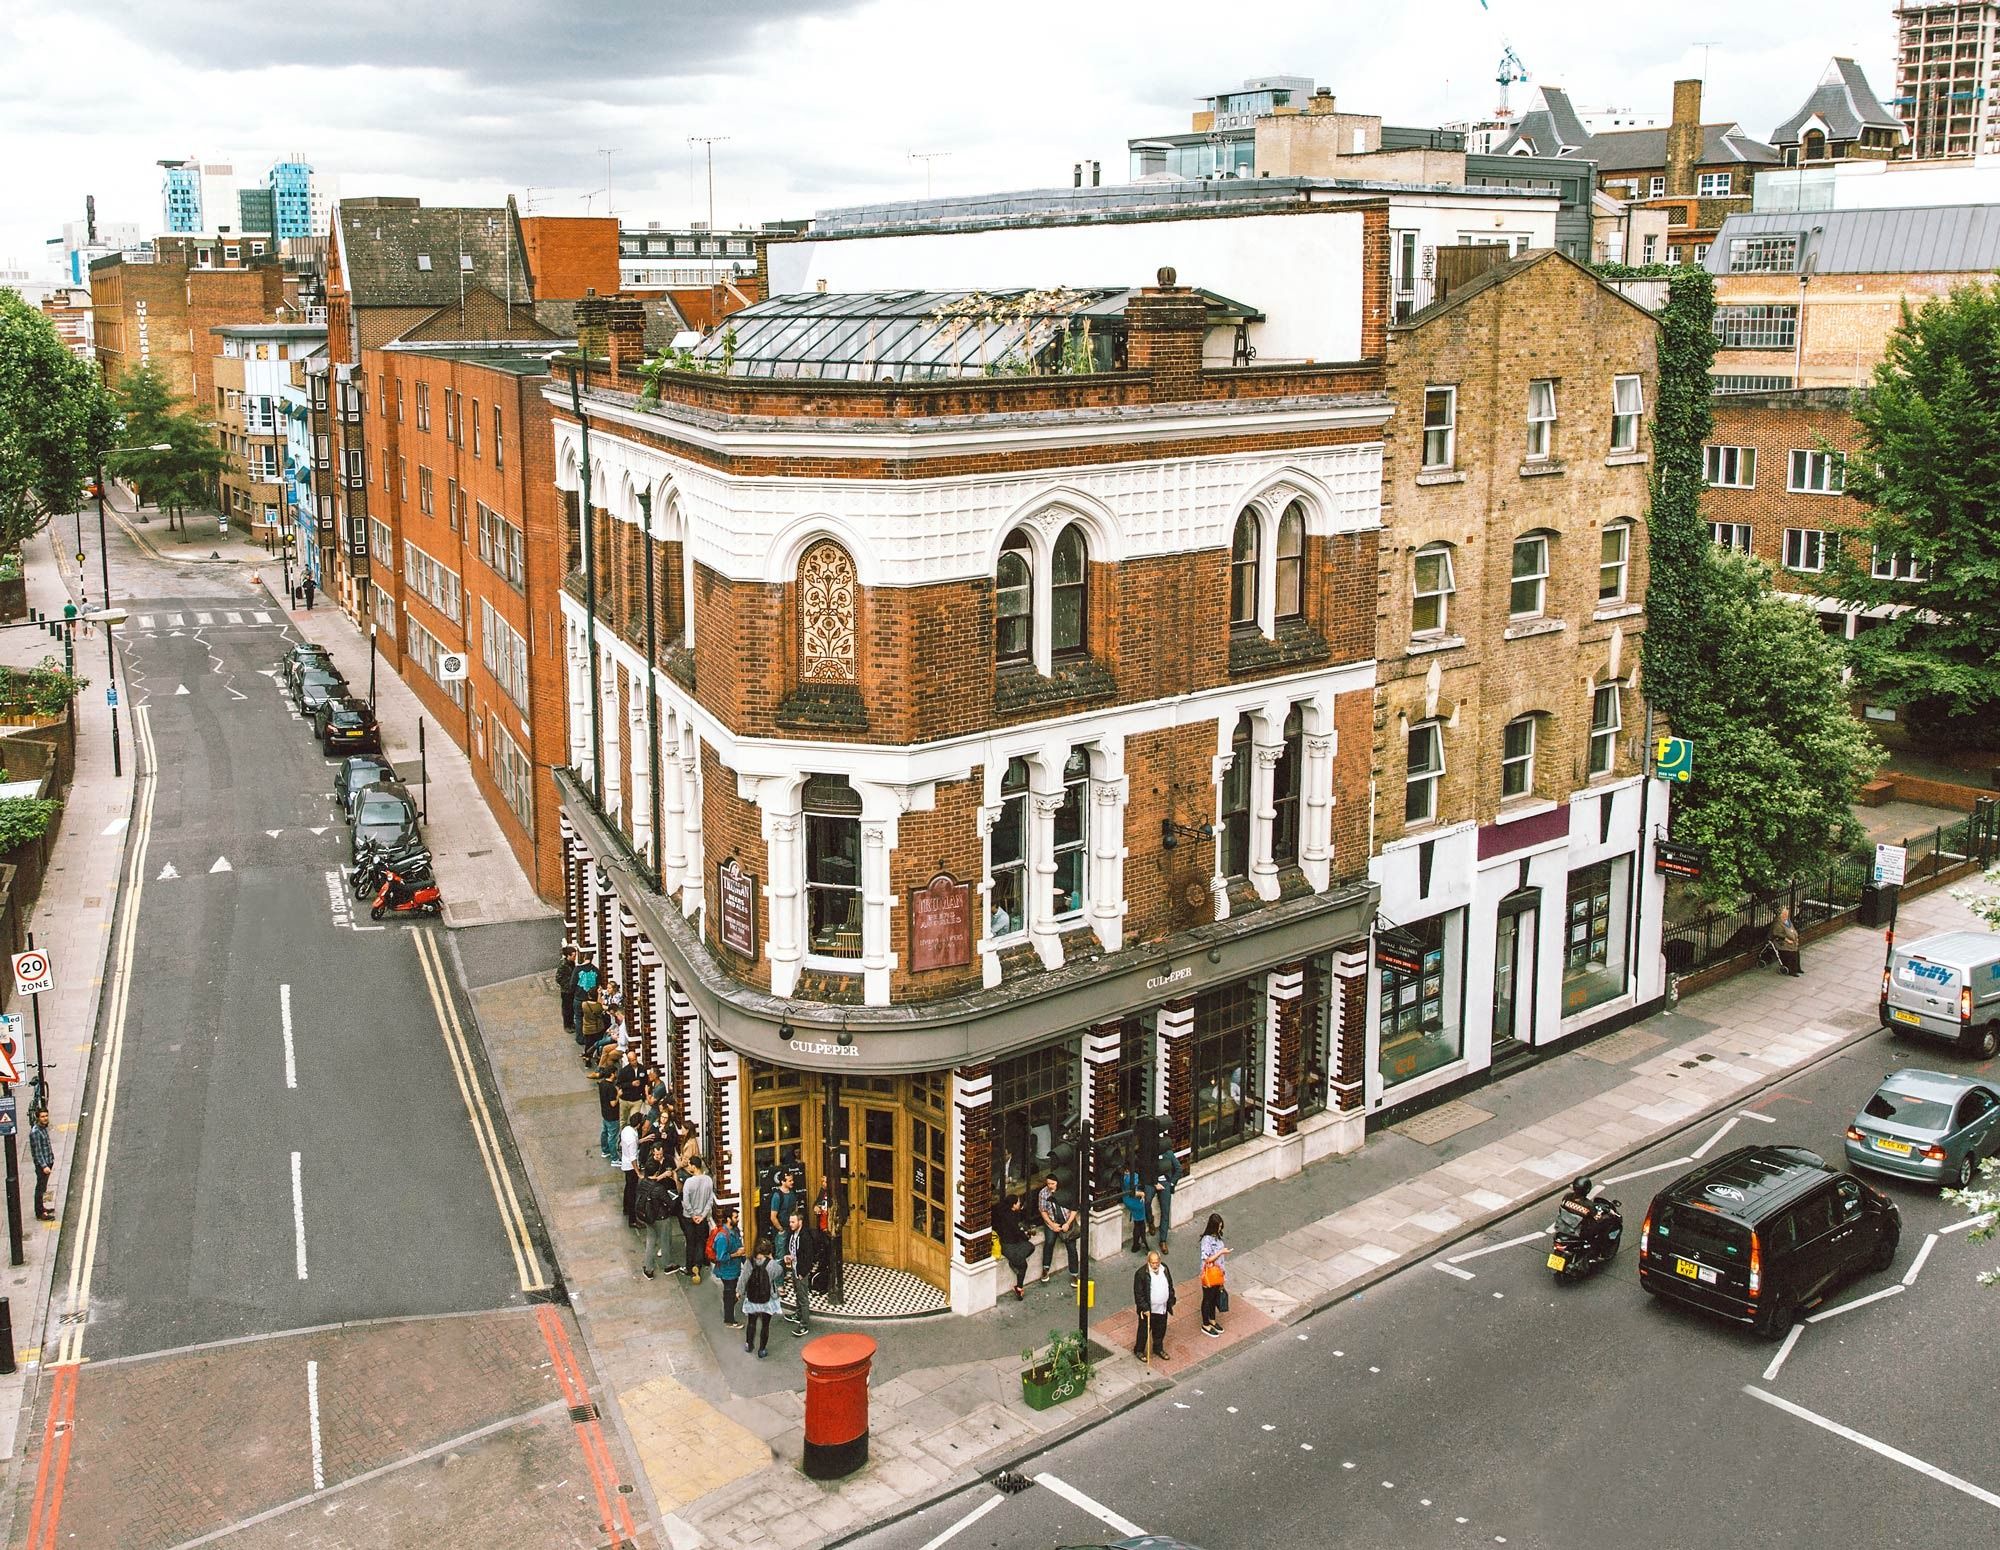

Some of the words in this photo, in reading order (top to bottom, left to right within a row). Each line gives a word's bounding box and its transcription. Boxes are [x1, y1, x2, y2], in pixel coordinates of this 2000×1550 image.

[136, 301, 150, 368] UNIVERSAL
[21, 960, 42, 974] 20
[1907, 960, 1953, 986] Thrifty
[21, 980, 49, 992] ZONE
[790, 1040, 859, 1056] CULPEPER
